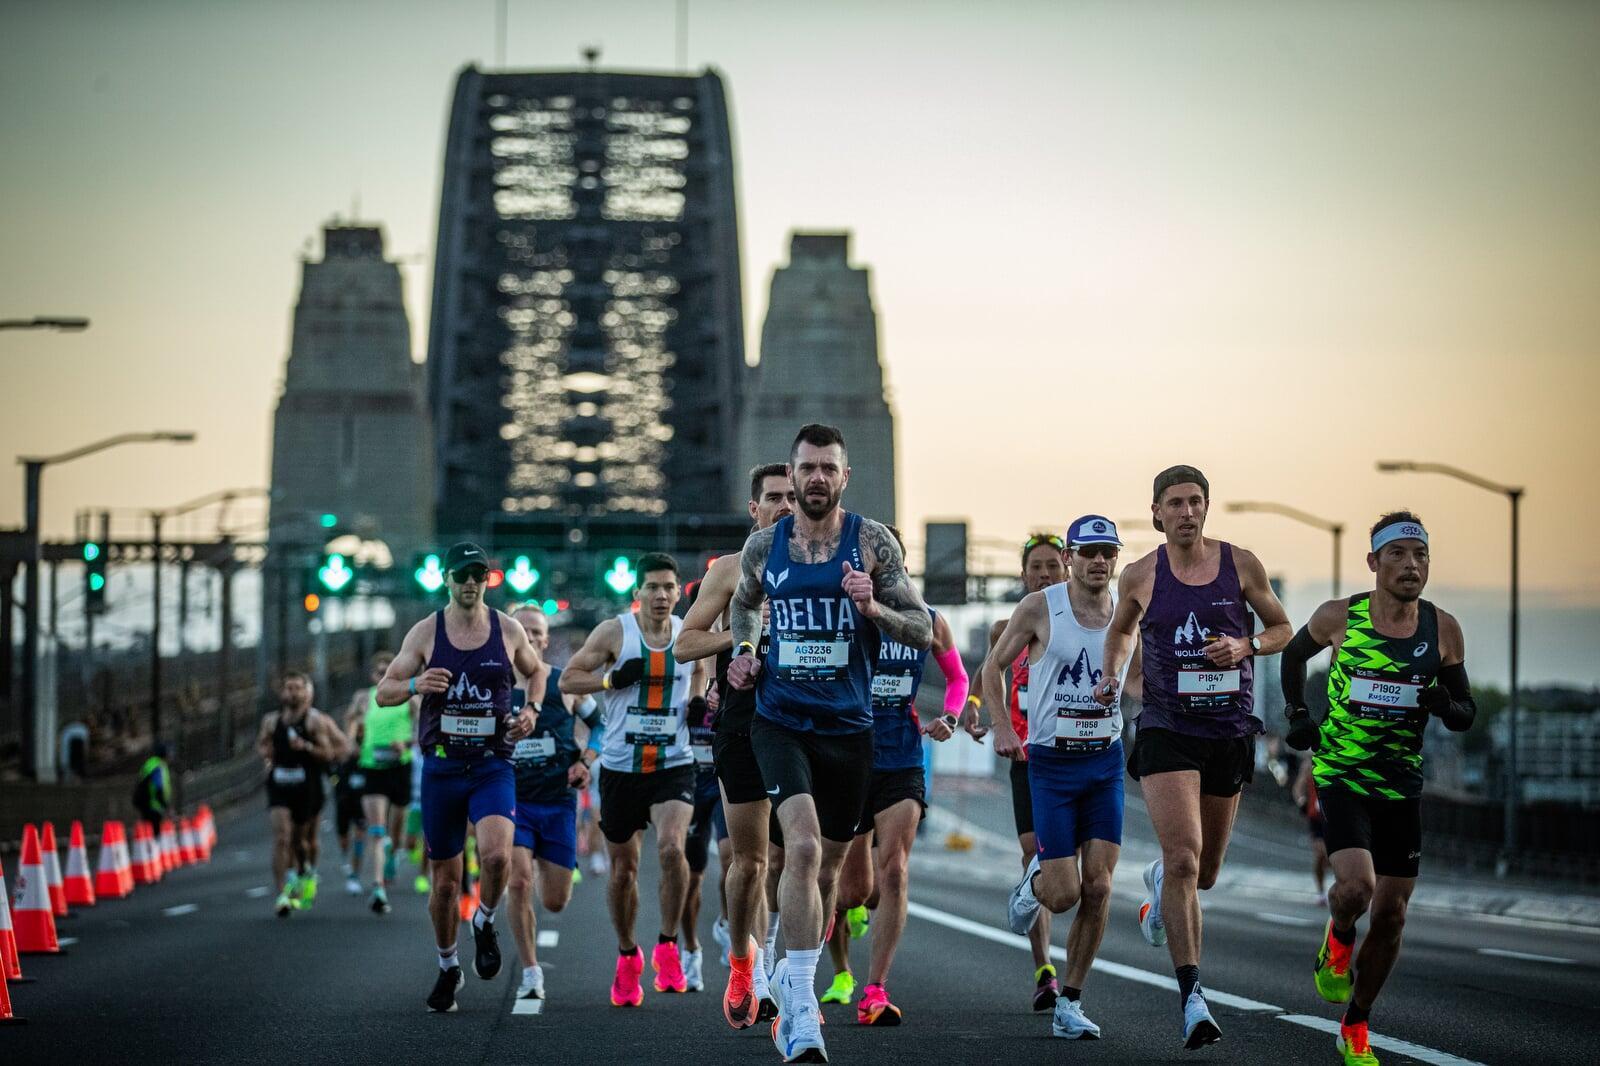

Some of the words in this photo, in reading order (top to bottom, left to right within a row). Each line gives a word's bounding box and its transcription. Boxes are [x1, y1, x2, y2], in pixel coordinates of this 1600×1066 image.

[772, 598, 855, 631] DELTA
[795, 645, 832, 655] AG3236
[879, 641, 918, 660] RWAY
[1174, 649, 1207, 657] WOLLO
[799, 656, 827, 664] PETRON
[1198, 674, 1224, 682] P1847
[1372, 683, 1401, 695] P1902
[1075, 720, 1098, 729] P1858
